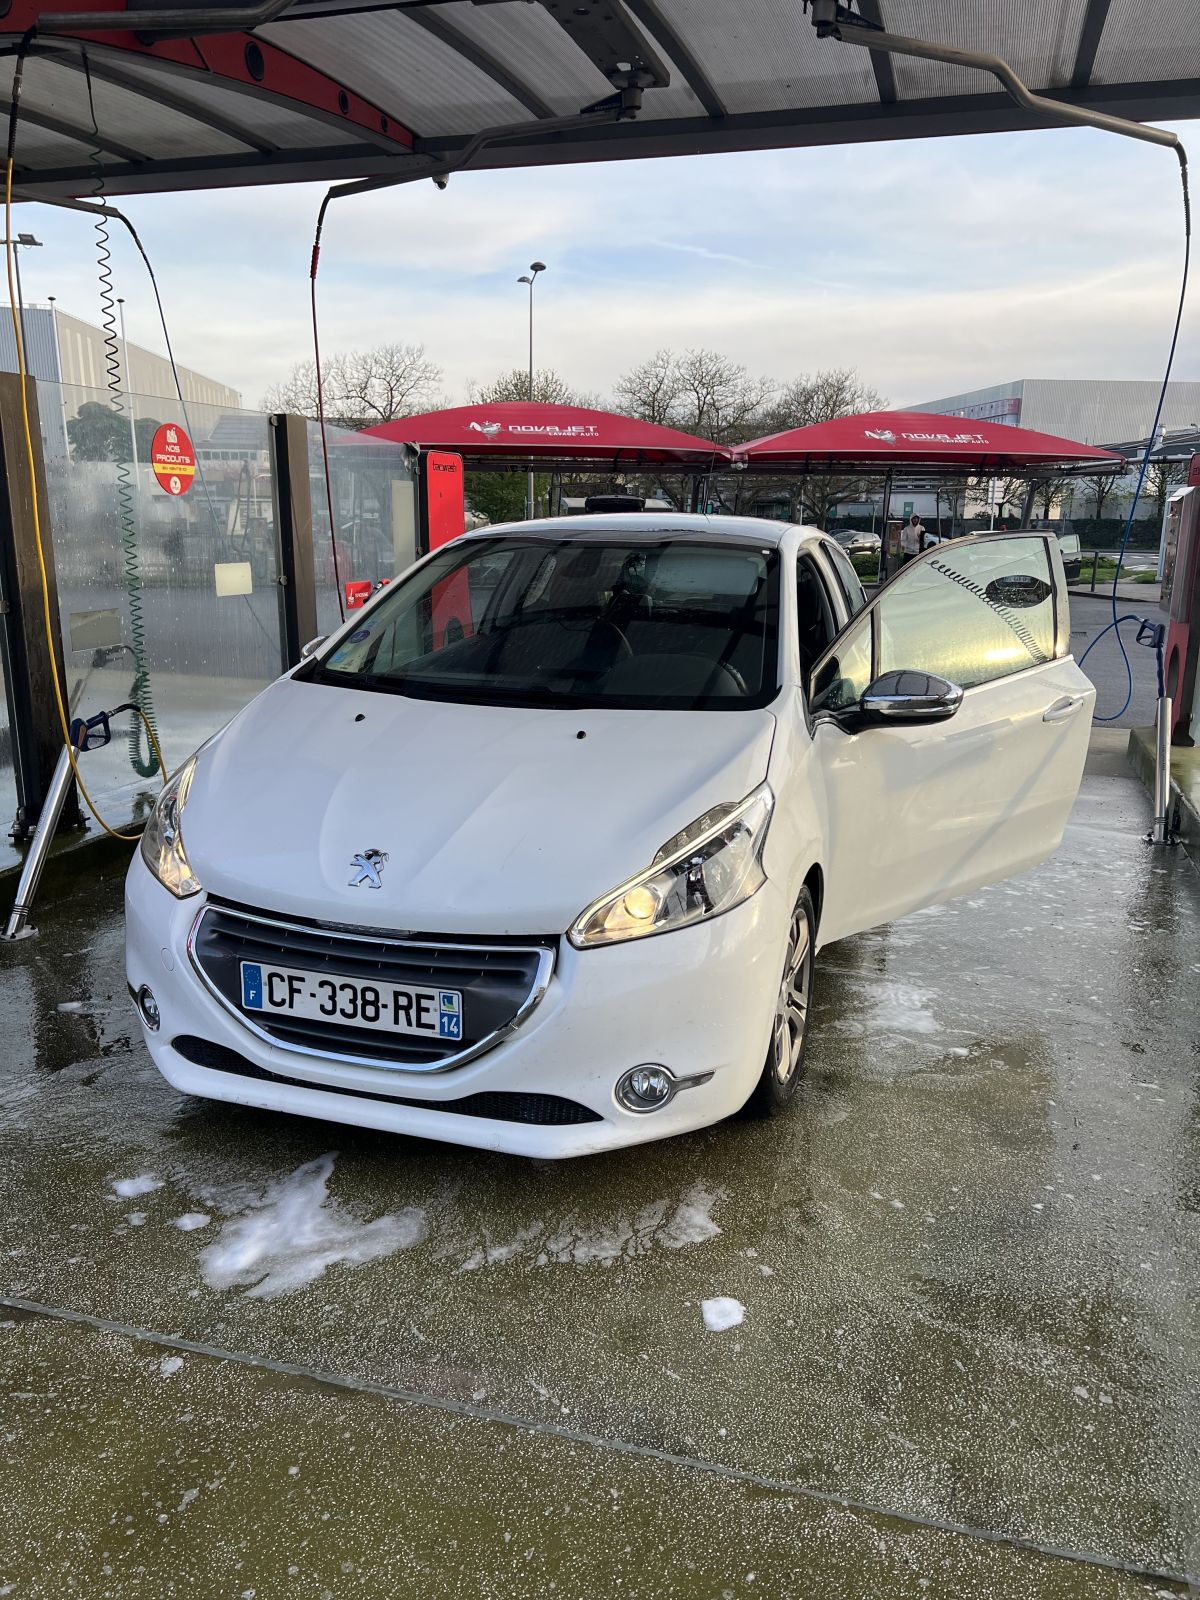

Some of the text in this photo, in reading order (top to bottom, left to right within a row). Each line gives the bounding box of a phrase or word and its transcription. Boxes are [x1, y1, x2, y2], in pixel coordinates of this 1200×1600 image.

[165, 445, 181, 453] NOS
[156, 454, 191, 464] PRODUITS
[249, 972, 459, 1035] F CF-338-RE 14
